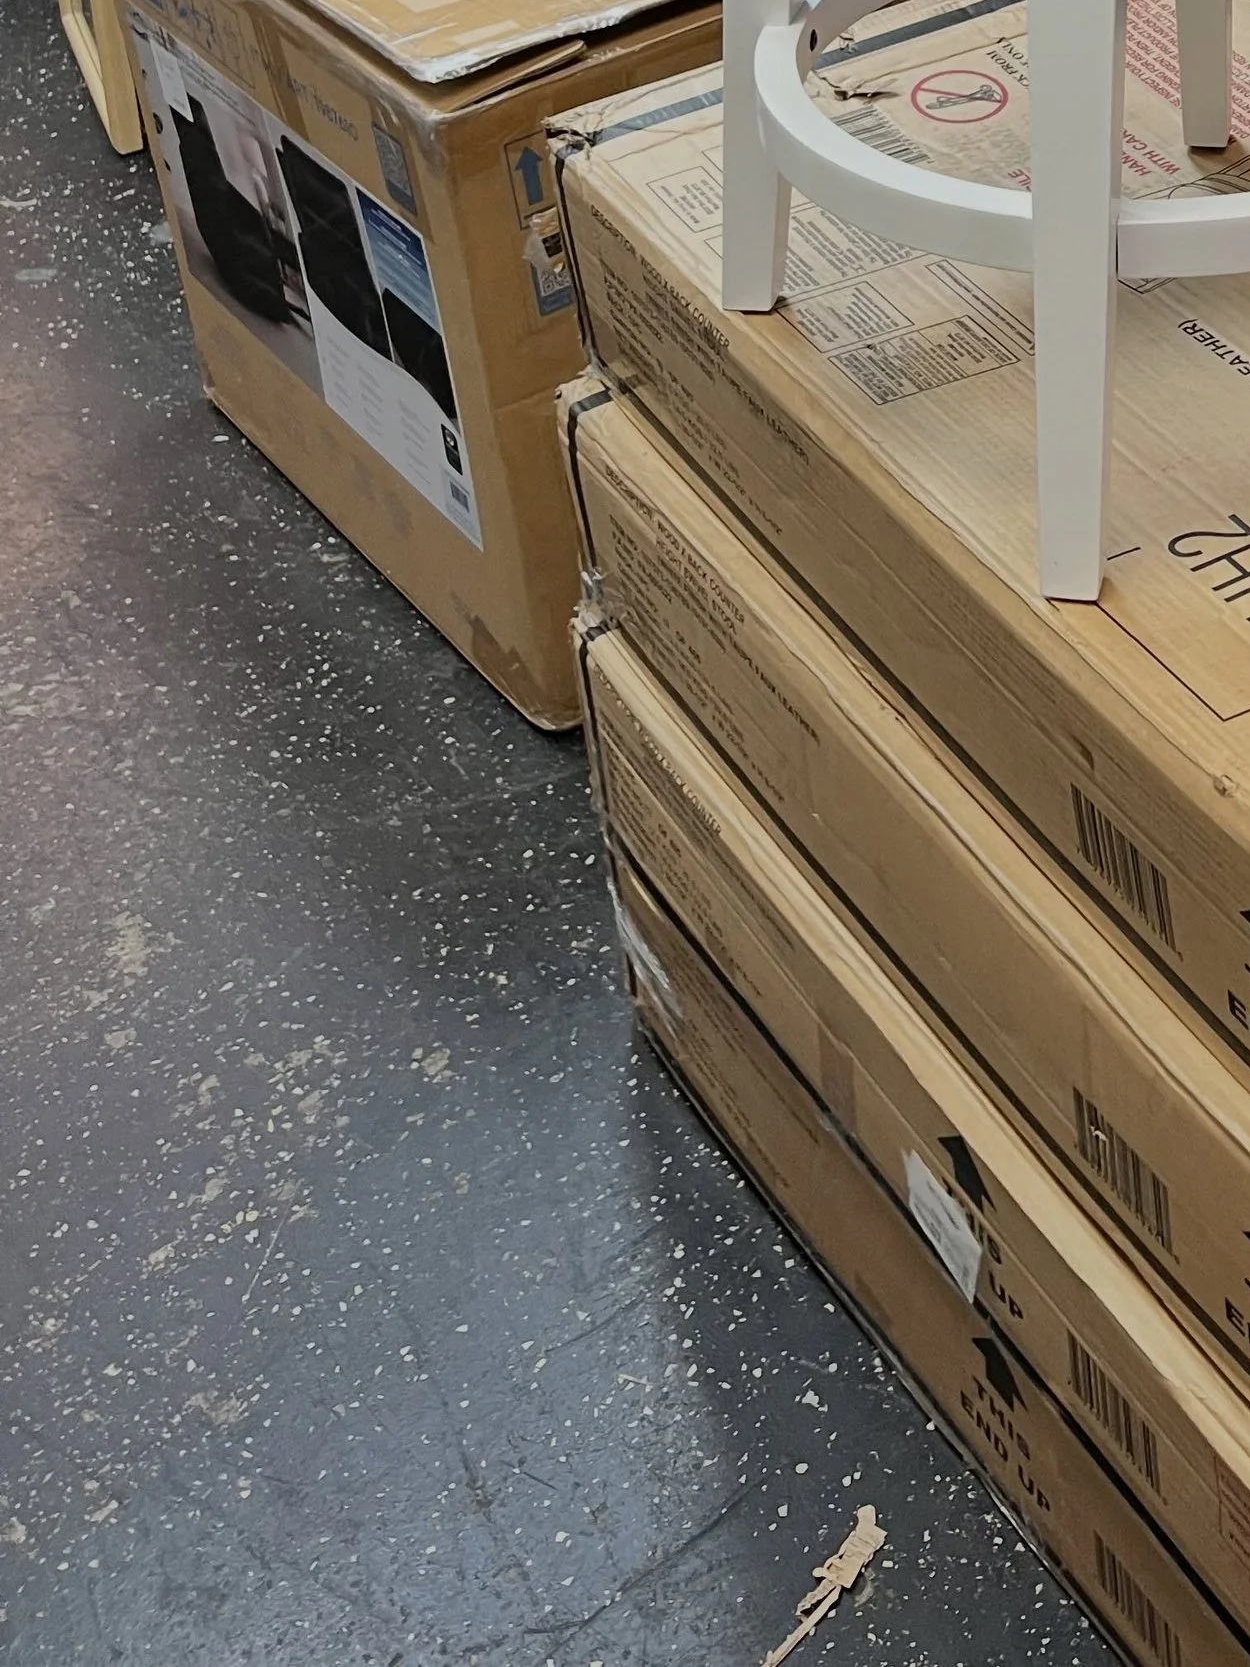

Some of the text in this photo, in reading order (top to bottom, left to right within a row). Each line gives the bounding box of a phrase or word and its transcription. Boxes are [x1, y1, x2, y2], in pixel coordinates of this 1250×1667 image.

[990, 1275, 1024, 1322] UP
[961, 1391, 1051, 1512] END UP
[970, 1377, 1031, 1462] THIS
